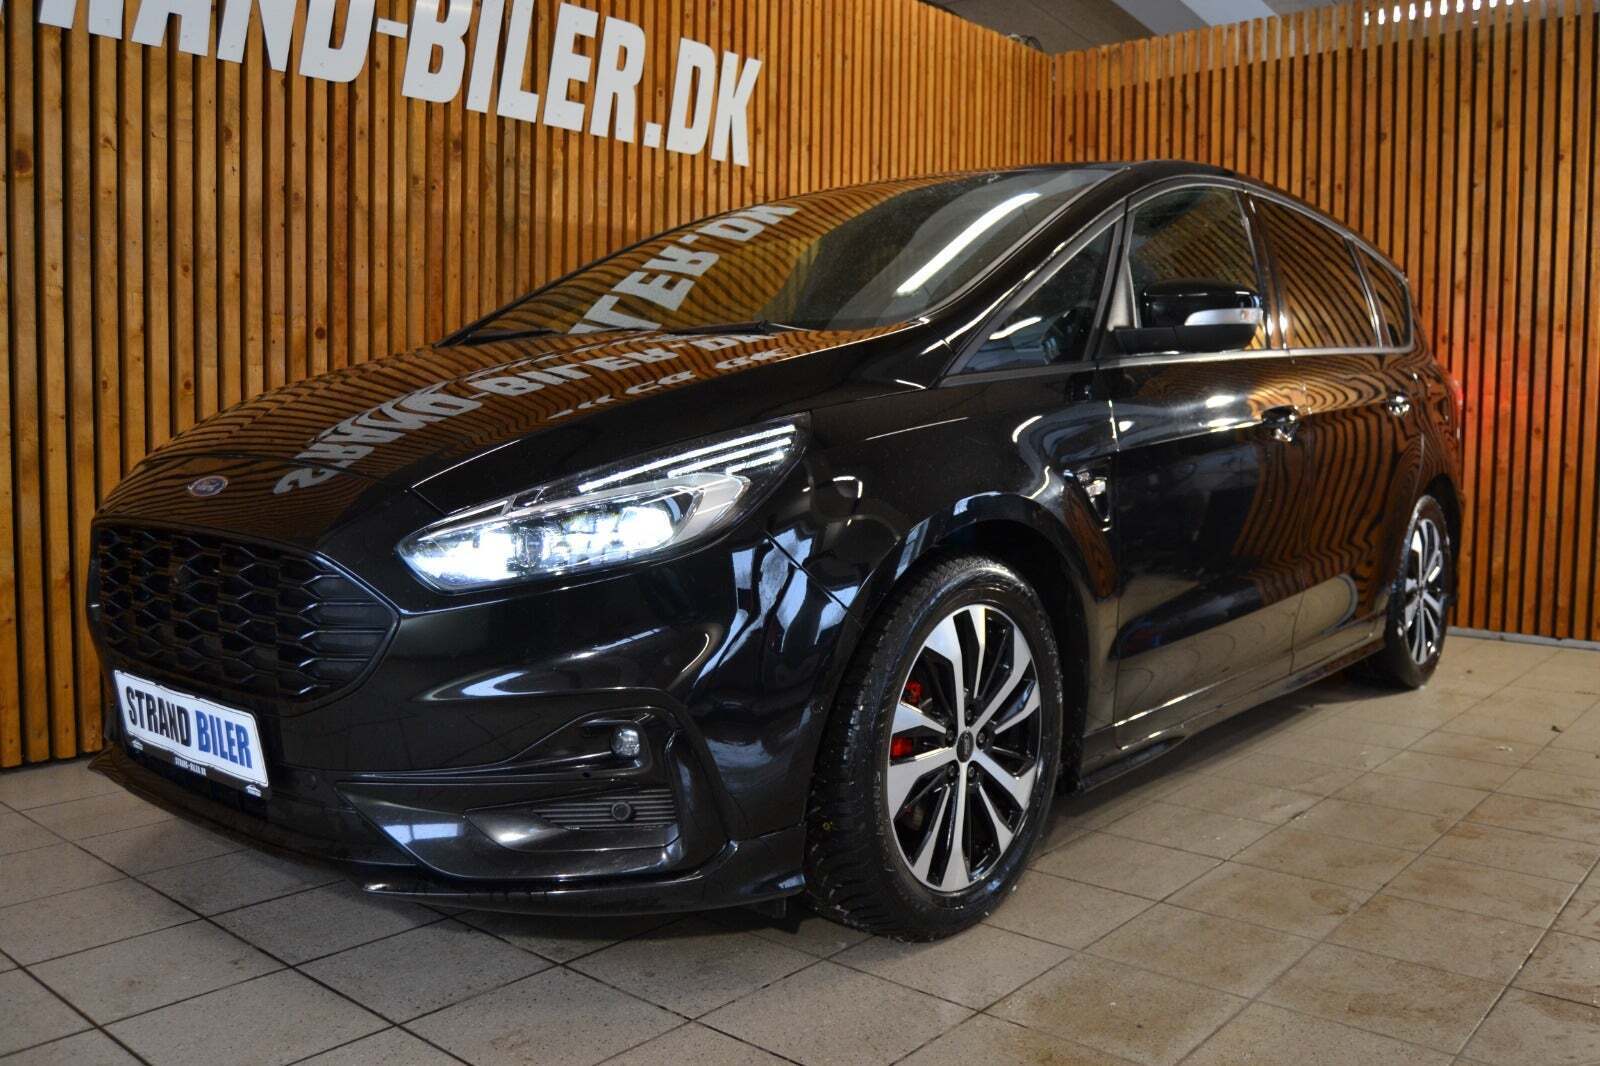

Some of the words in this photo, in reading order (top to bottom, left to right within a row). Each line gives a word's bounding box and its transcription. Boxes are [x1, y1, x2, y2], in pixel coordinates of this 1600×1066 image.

[38, 0, 762, 167] D-BILER.DK
[126, 686, 192, 748] STRAND
[195, 711, 253, 769] BILER
